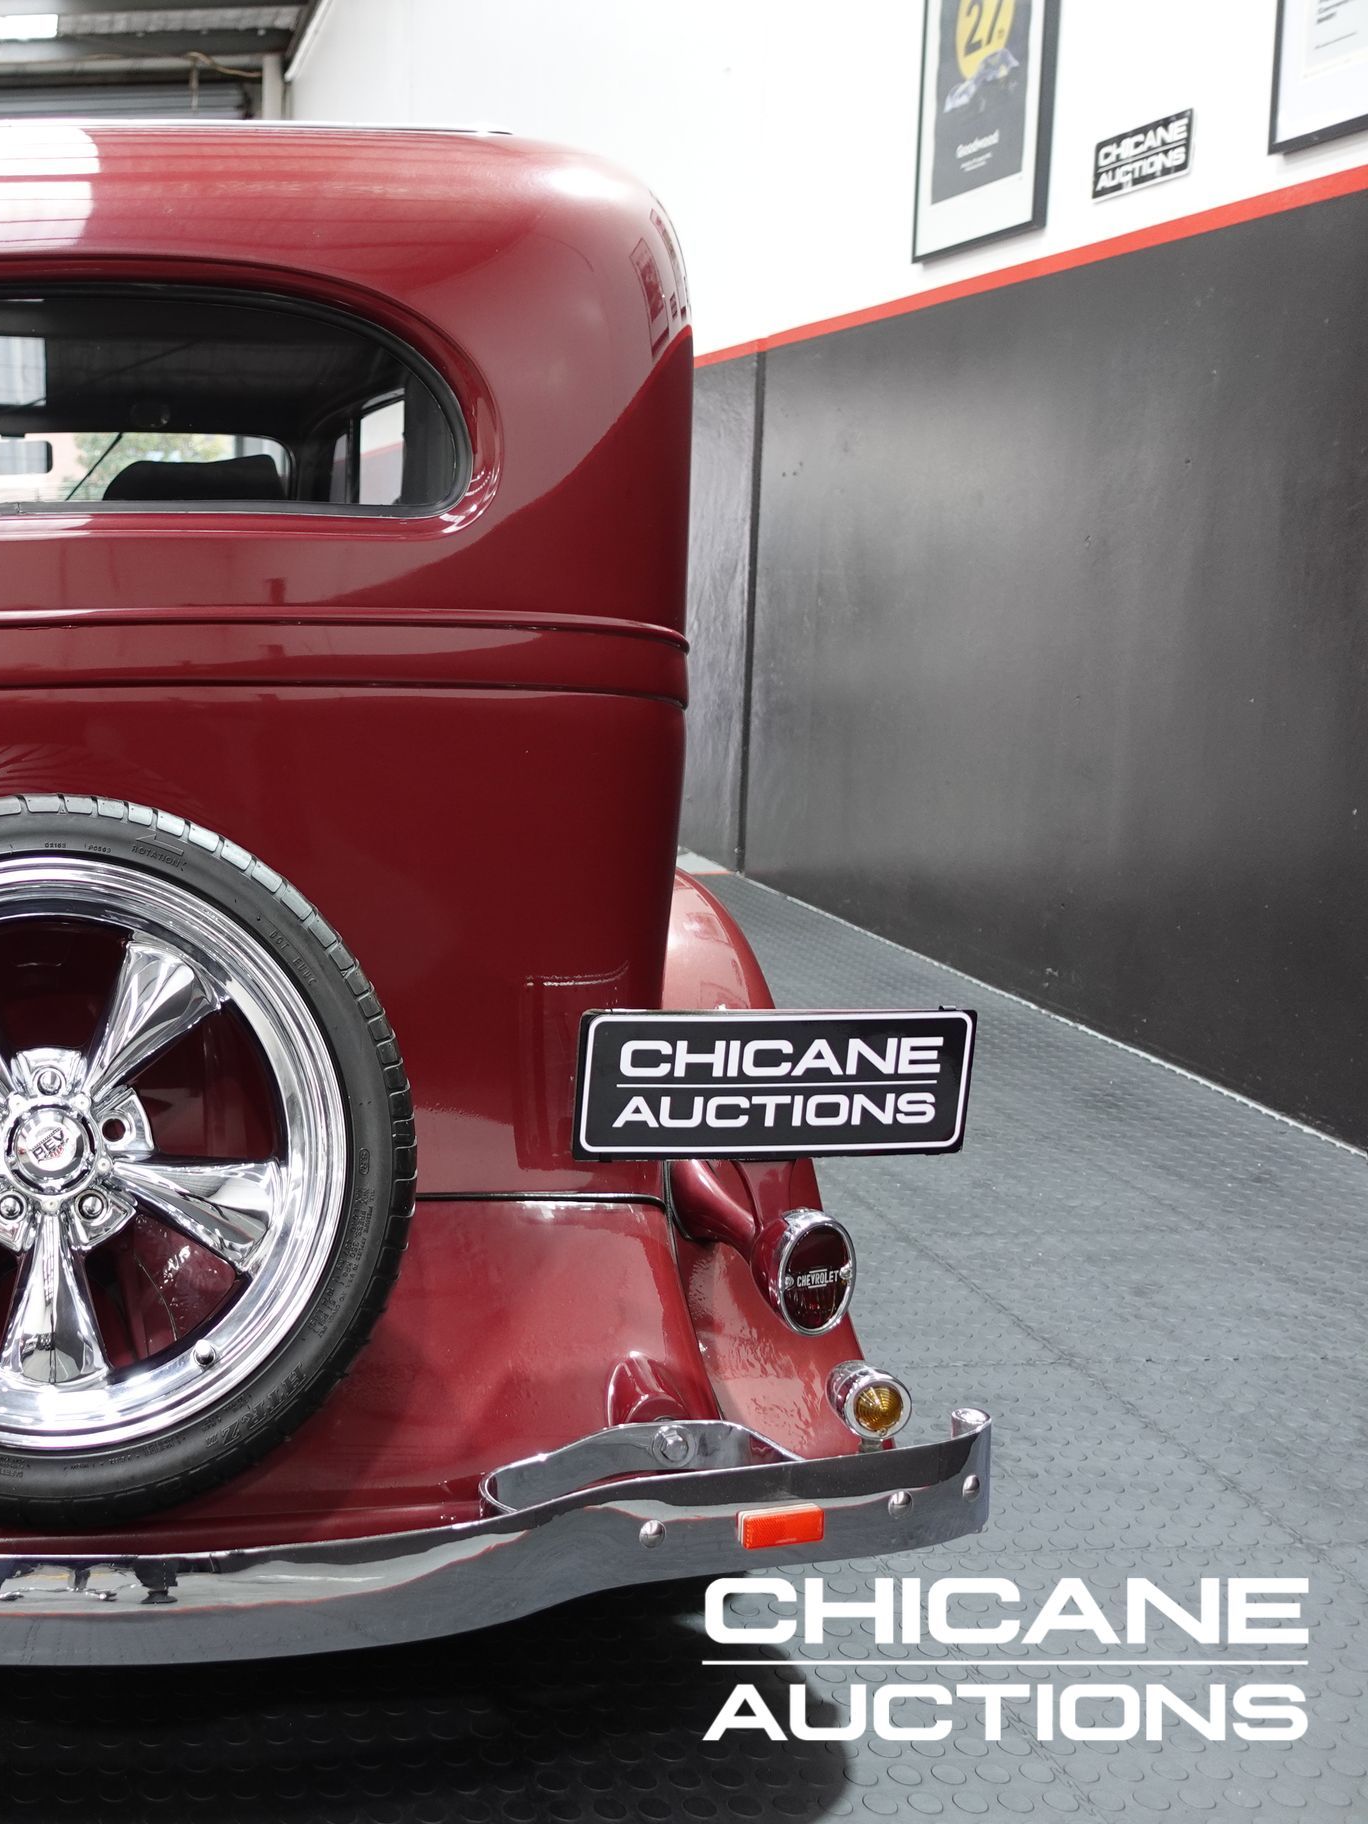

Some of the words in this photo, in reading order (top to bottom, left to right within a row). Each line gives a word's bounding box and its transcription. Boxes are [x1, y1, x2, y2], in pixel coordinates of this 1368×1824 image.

[1098, 117, 1189, 167] CHICANE
[1095, 146, 1187, 191] AUCTIONS
[132, 845, 181, 868] ROTATION
[619, 1037, 944, 1078] CHICANE
[612, 1092, 936, 1128] AUCTIONS
[796, 1270, 840, 1288] CHEVROLET
